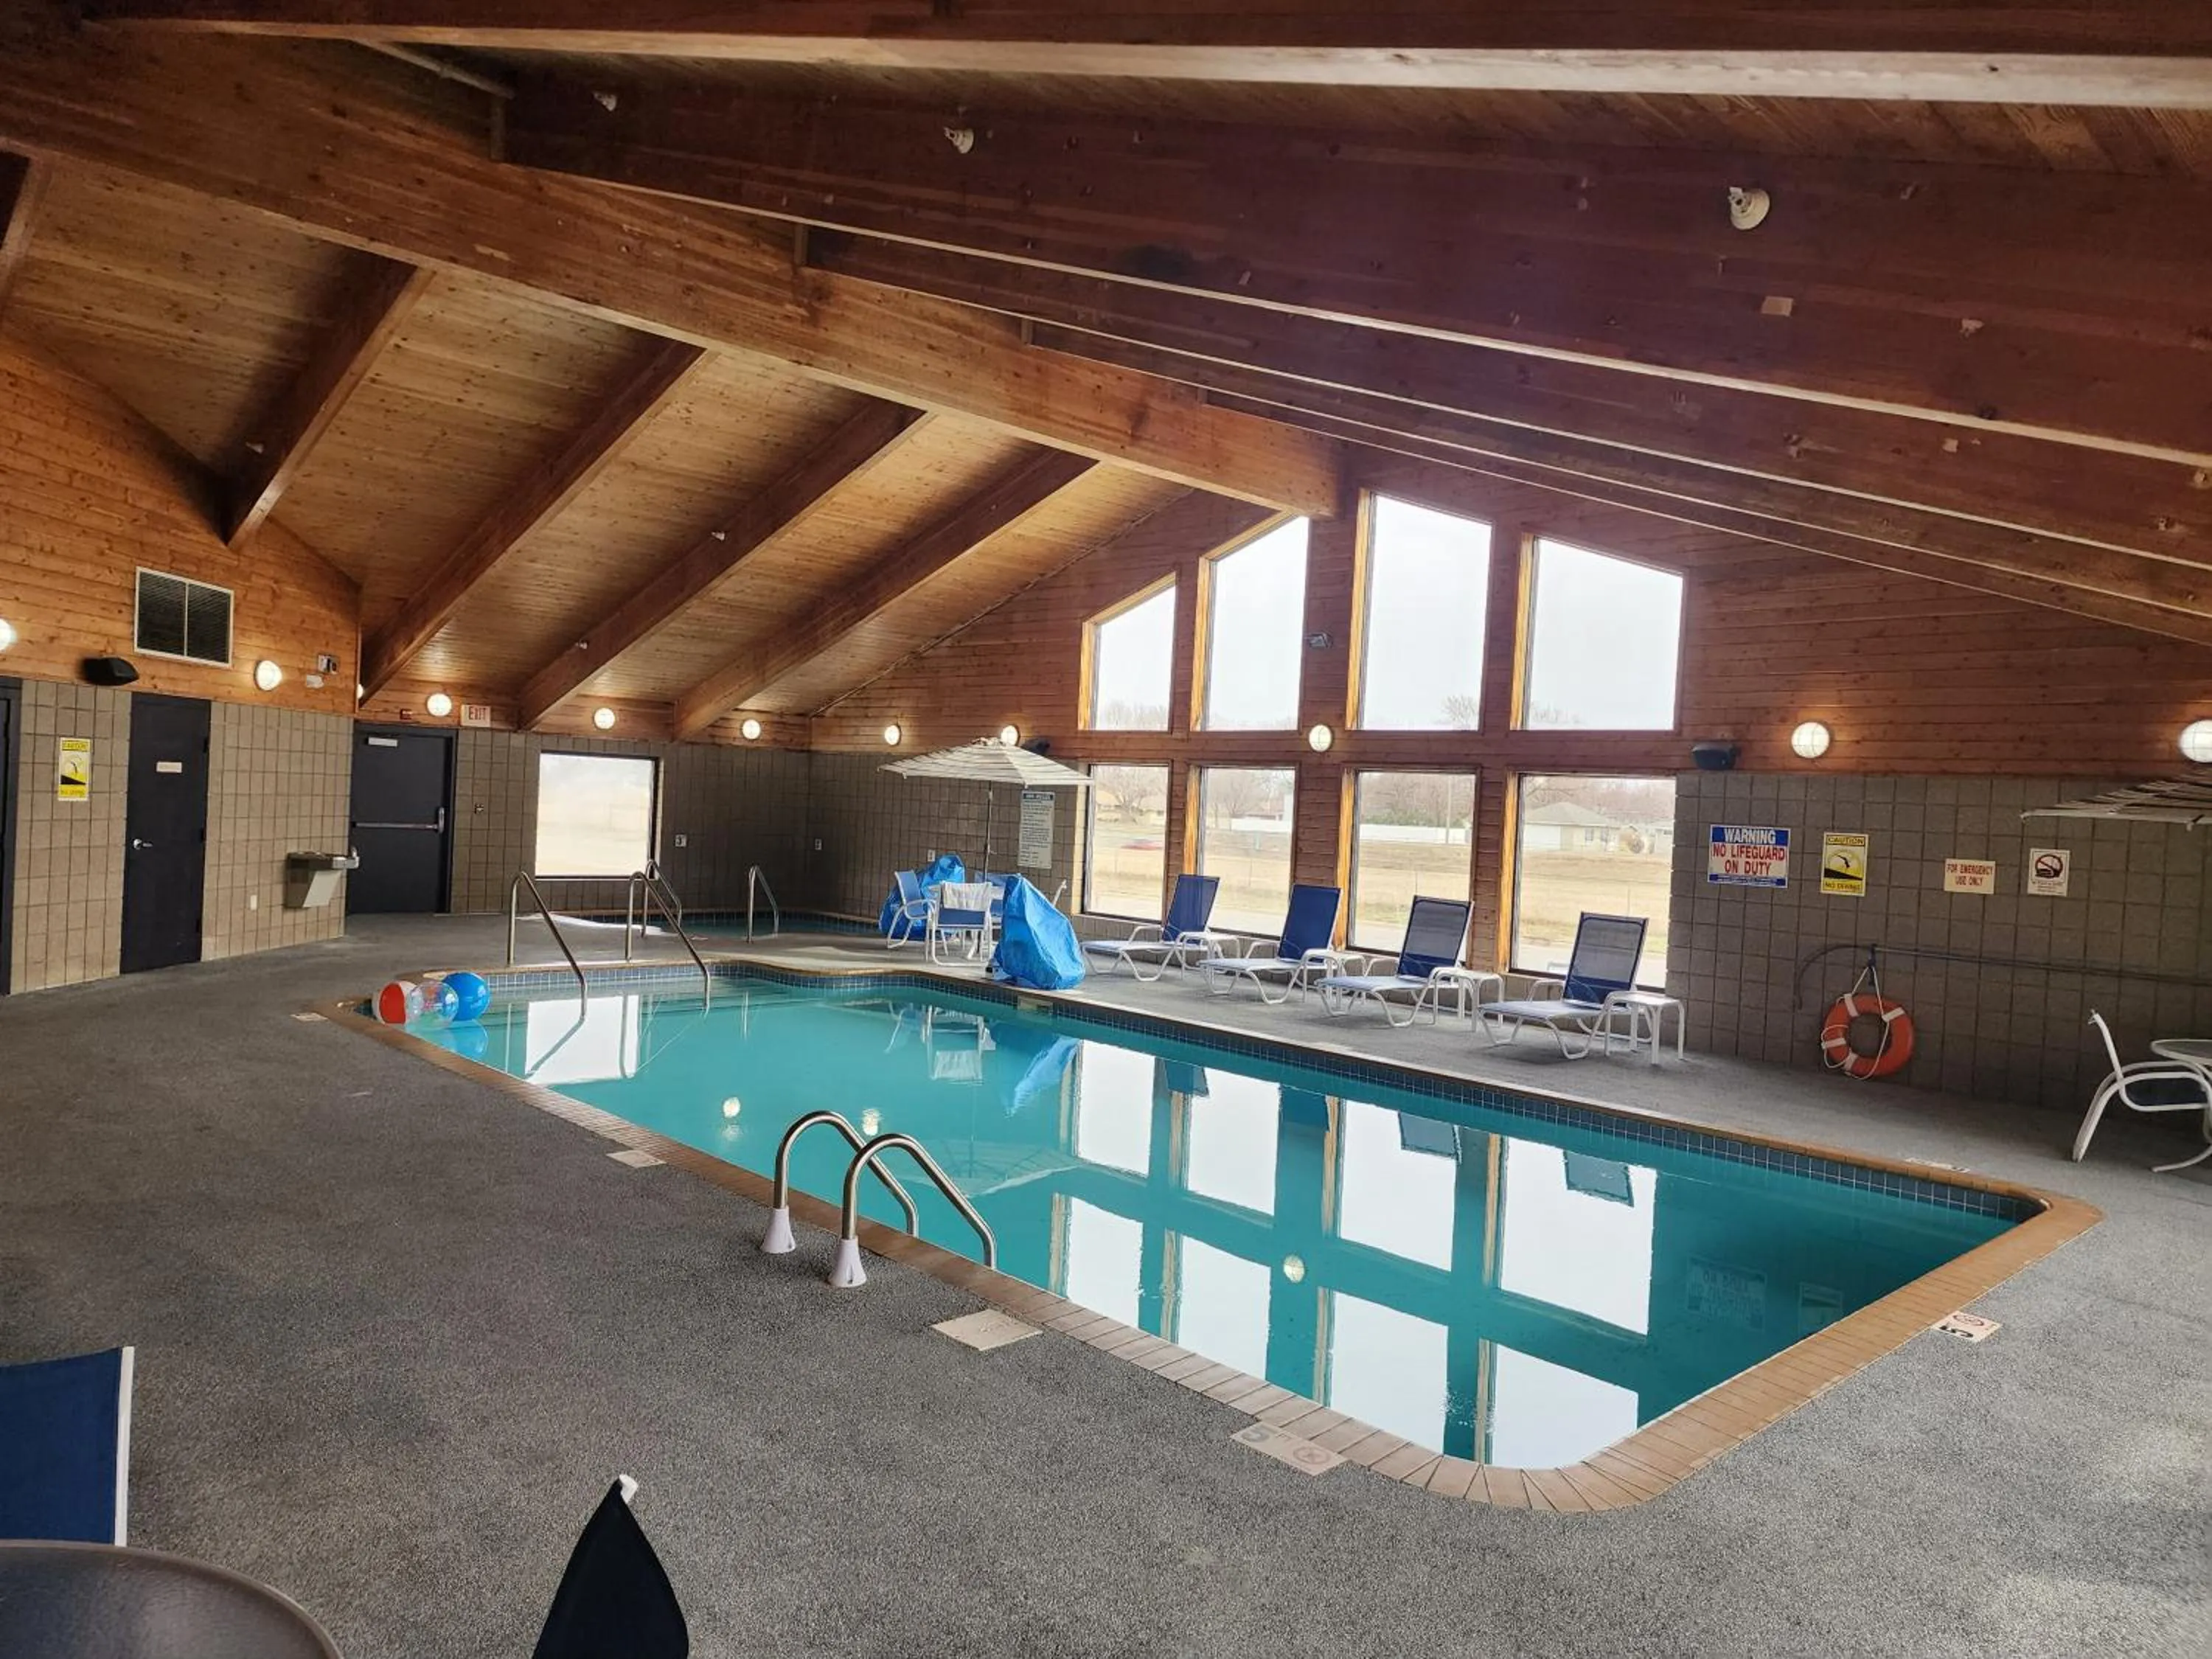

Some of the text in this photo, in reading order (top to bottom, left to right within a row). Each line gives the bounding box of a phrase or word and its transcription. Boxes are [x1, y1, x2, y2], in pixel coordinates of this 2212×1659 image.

[469, 706, 486, 720] EXIT
[1724, 827, 1776, 844] WARNING
[1713, 844, 1785, 861] NO LIFEGUARD
[1725, 860, 1771, 875] ON DUTY
